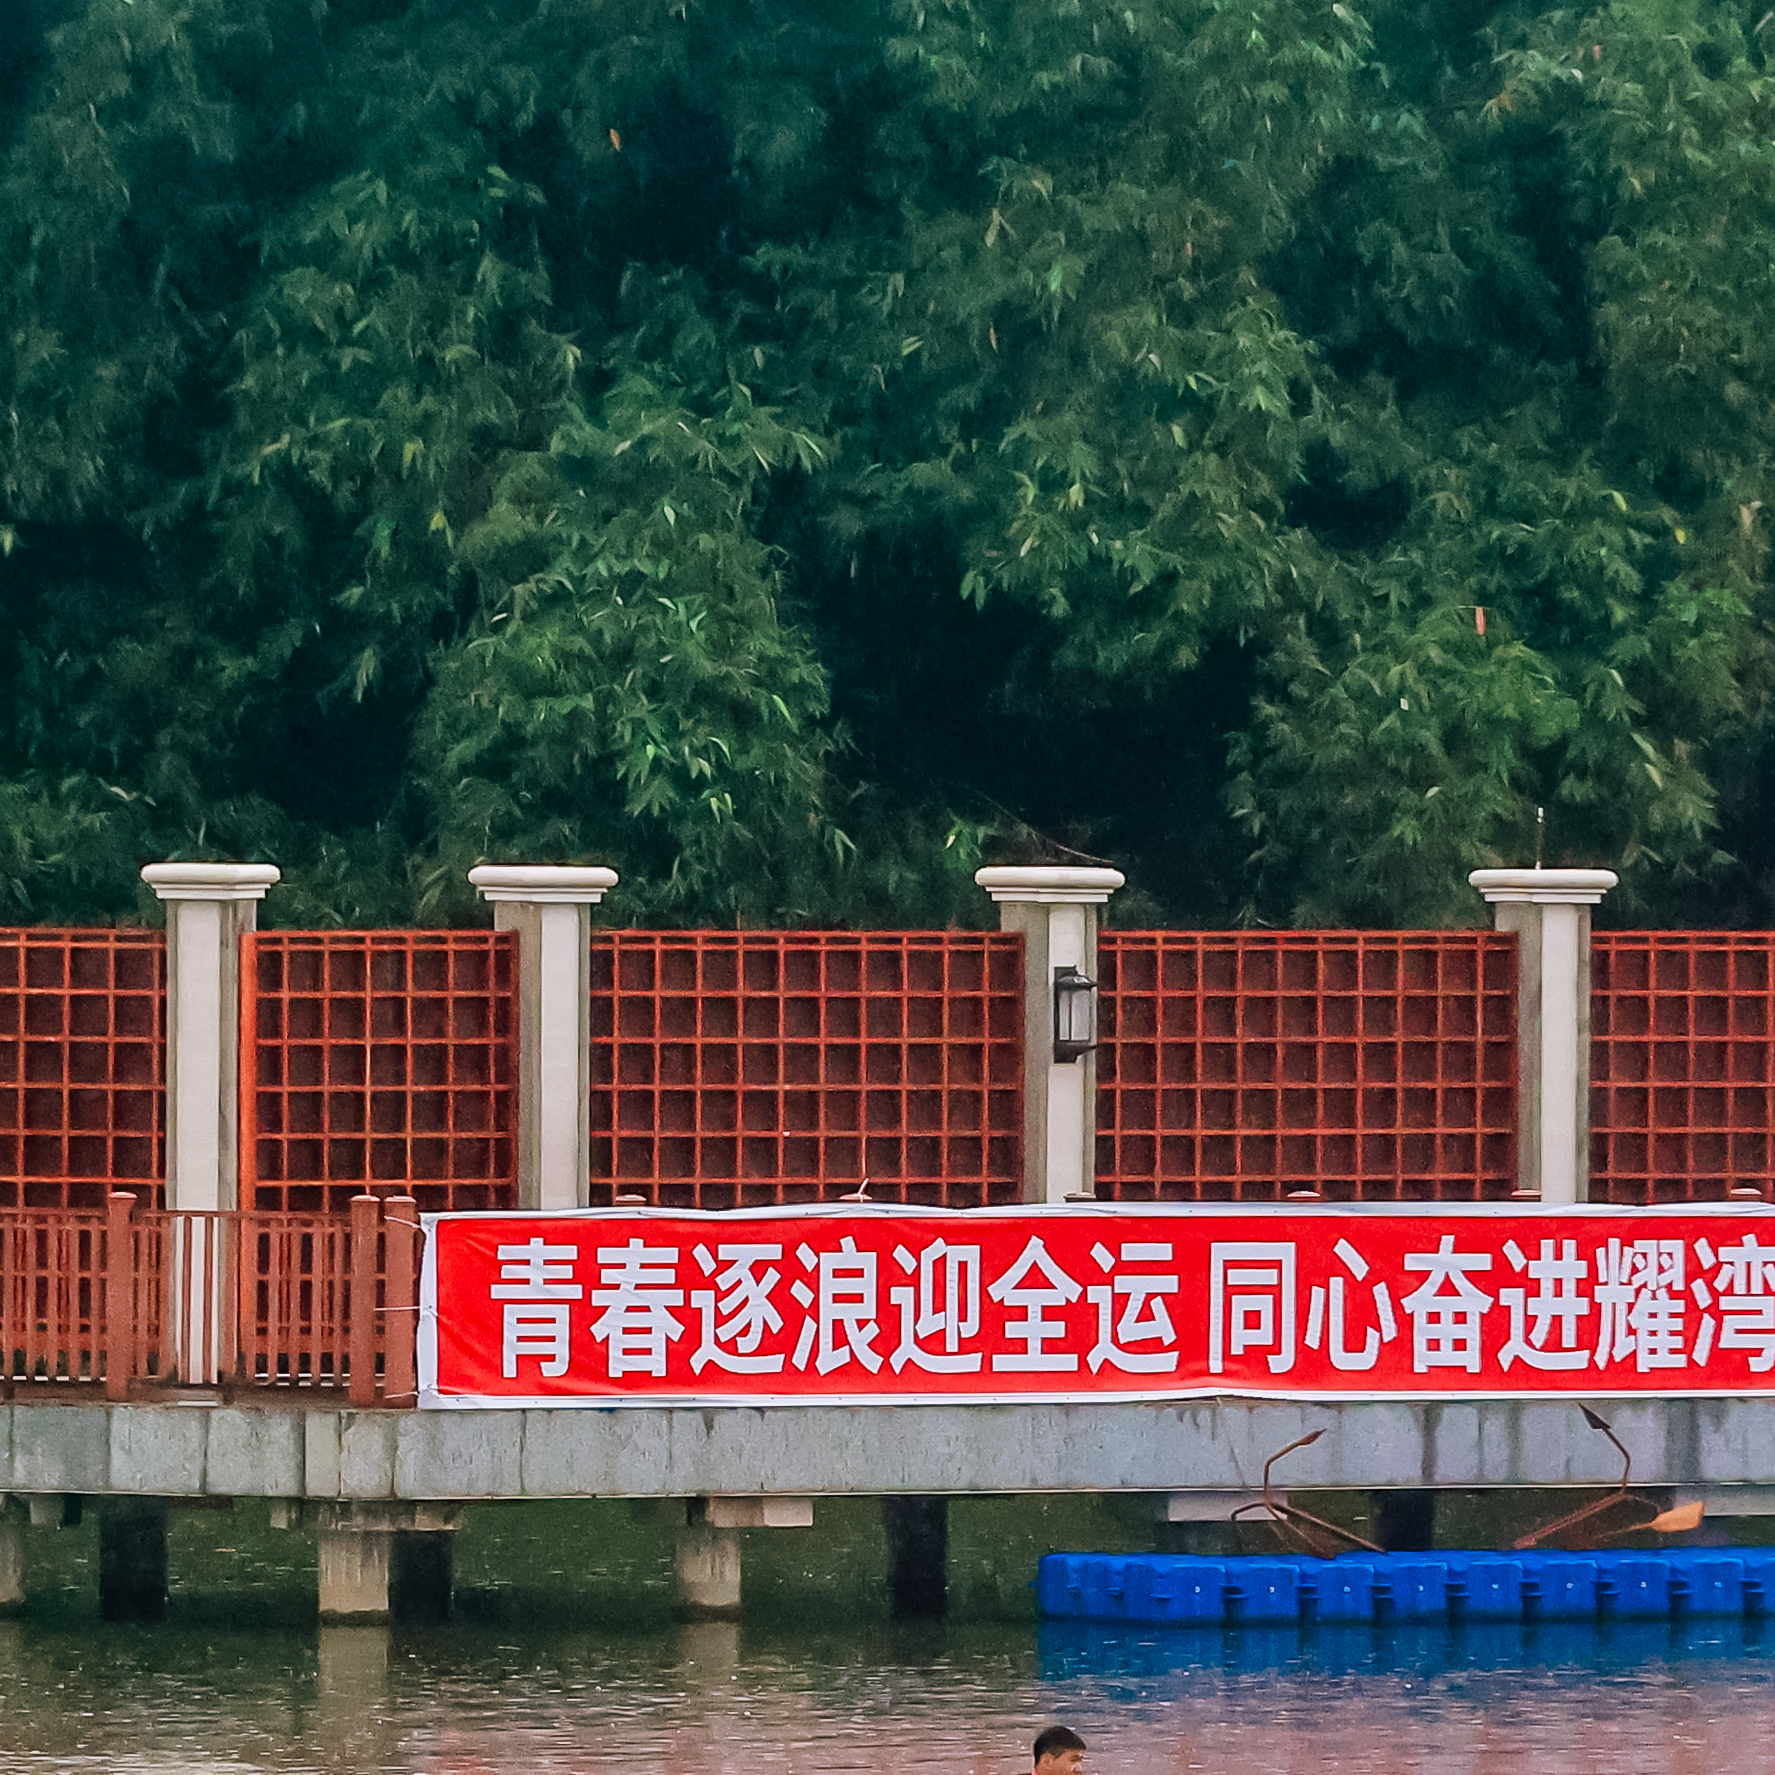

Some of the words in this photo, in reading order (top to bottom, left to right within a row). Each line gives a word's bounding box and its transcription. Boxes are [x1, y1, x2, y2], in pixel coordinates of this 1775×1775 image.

[490, 1235, 1180, 1378] 青春逐浪迎全运
